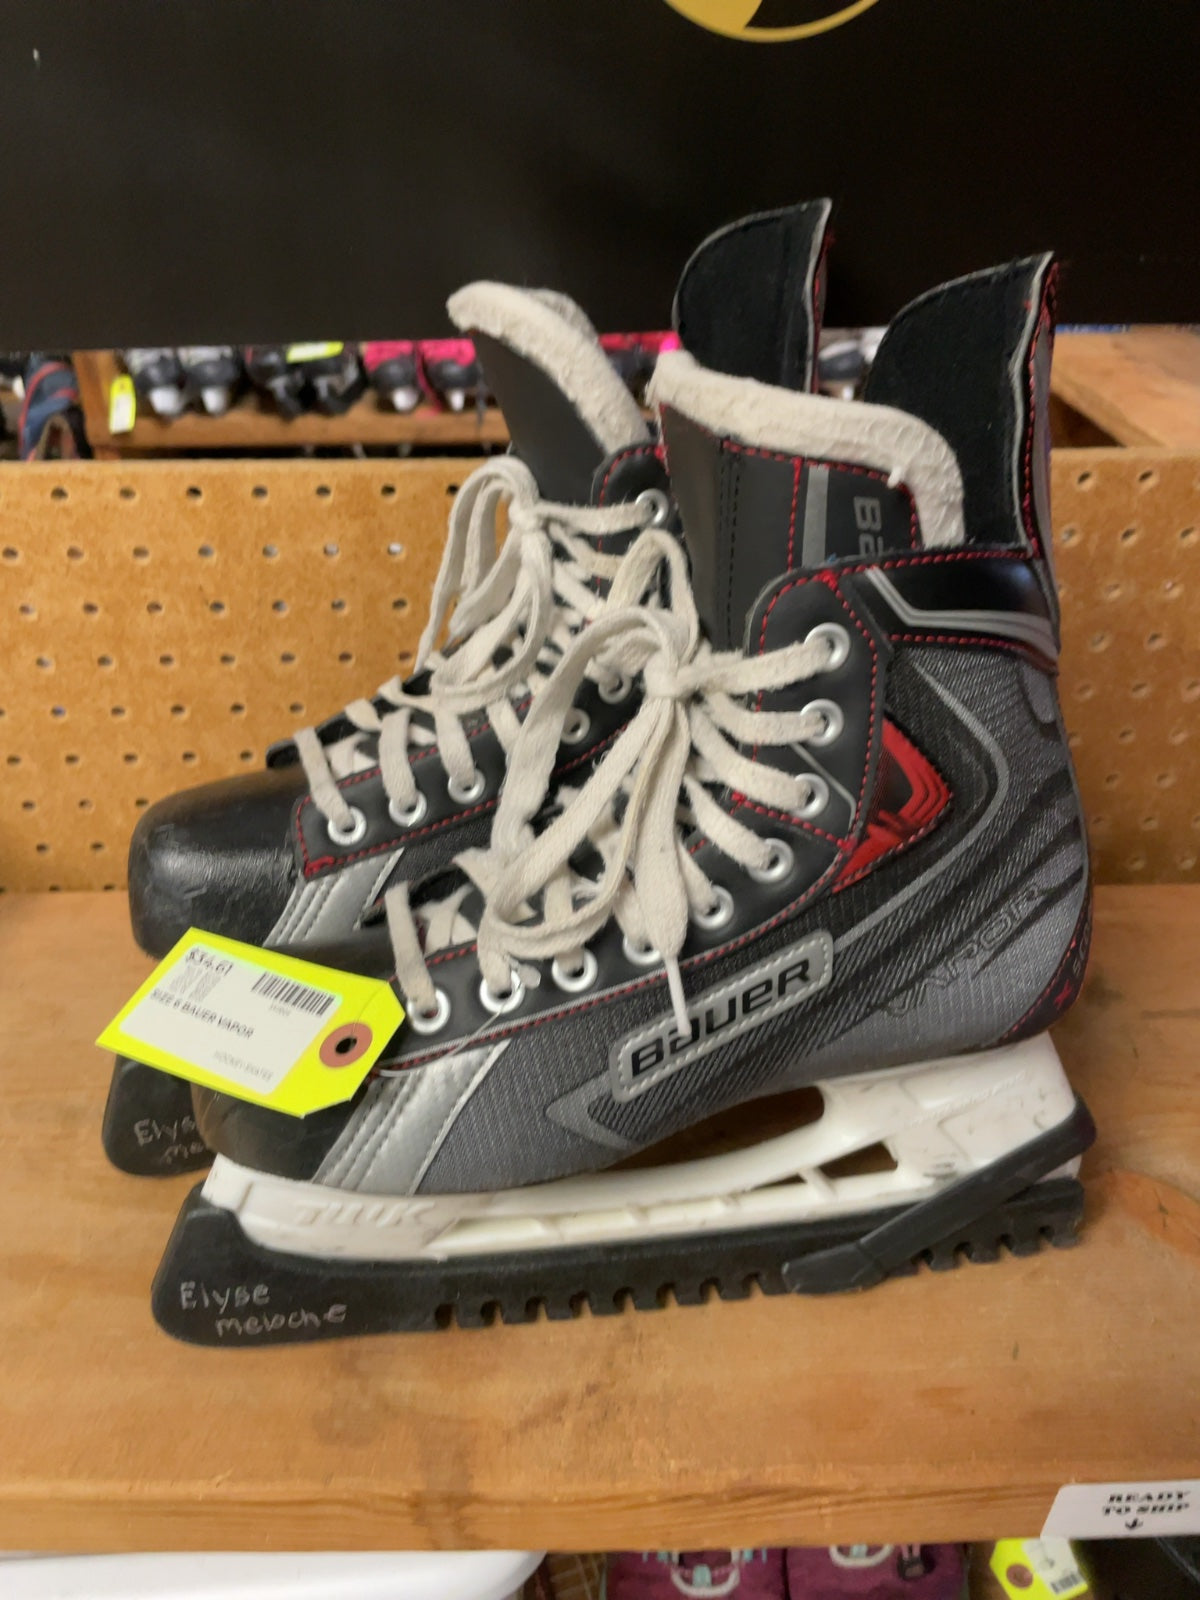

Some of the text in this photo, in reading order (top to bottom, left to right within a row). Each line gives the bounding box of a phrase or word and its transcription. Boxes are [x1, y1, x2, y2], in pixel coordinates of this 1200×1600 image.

[181, 1000, 217, 1024] BAUER
[217, 1016, 255, 1039] VAPOR
[1107, 1491, 1191, 1503] READY
[1102, 1501, 1190, 1517] TO SHIP
